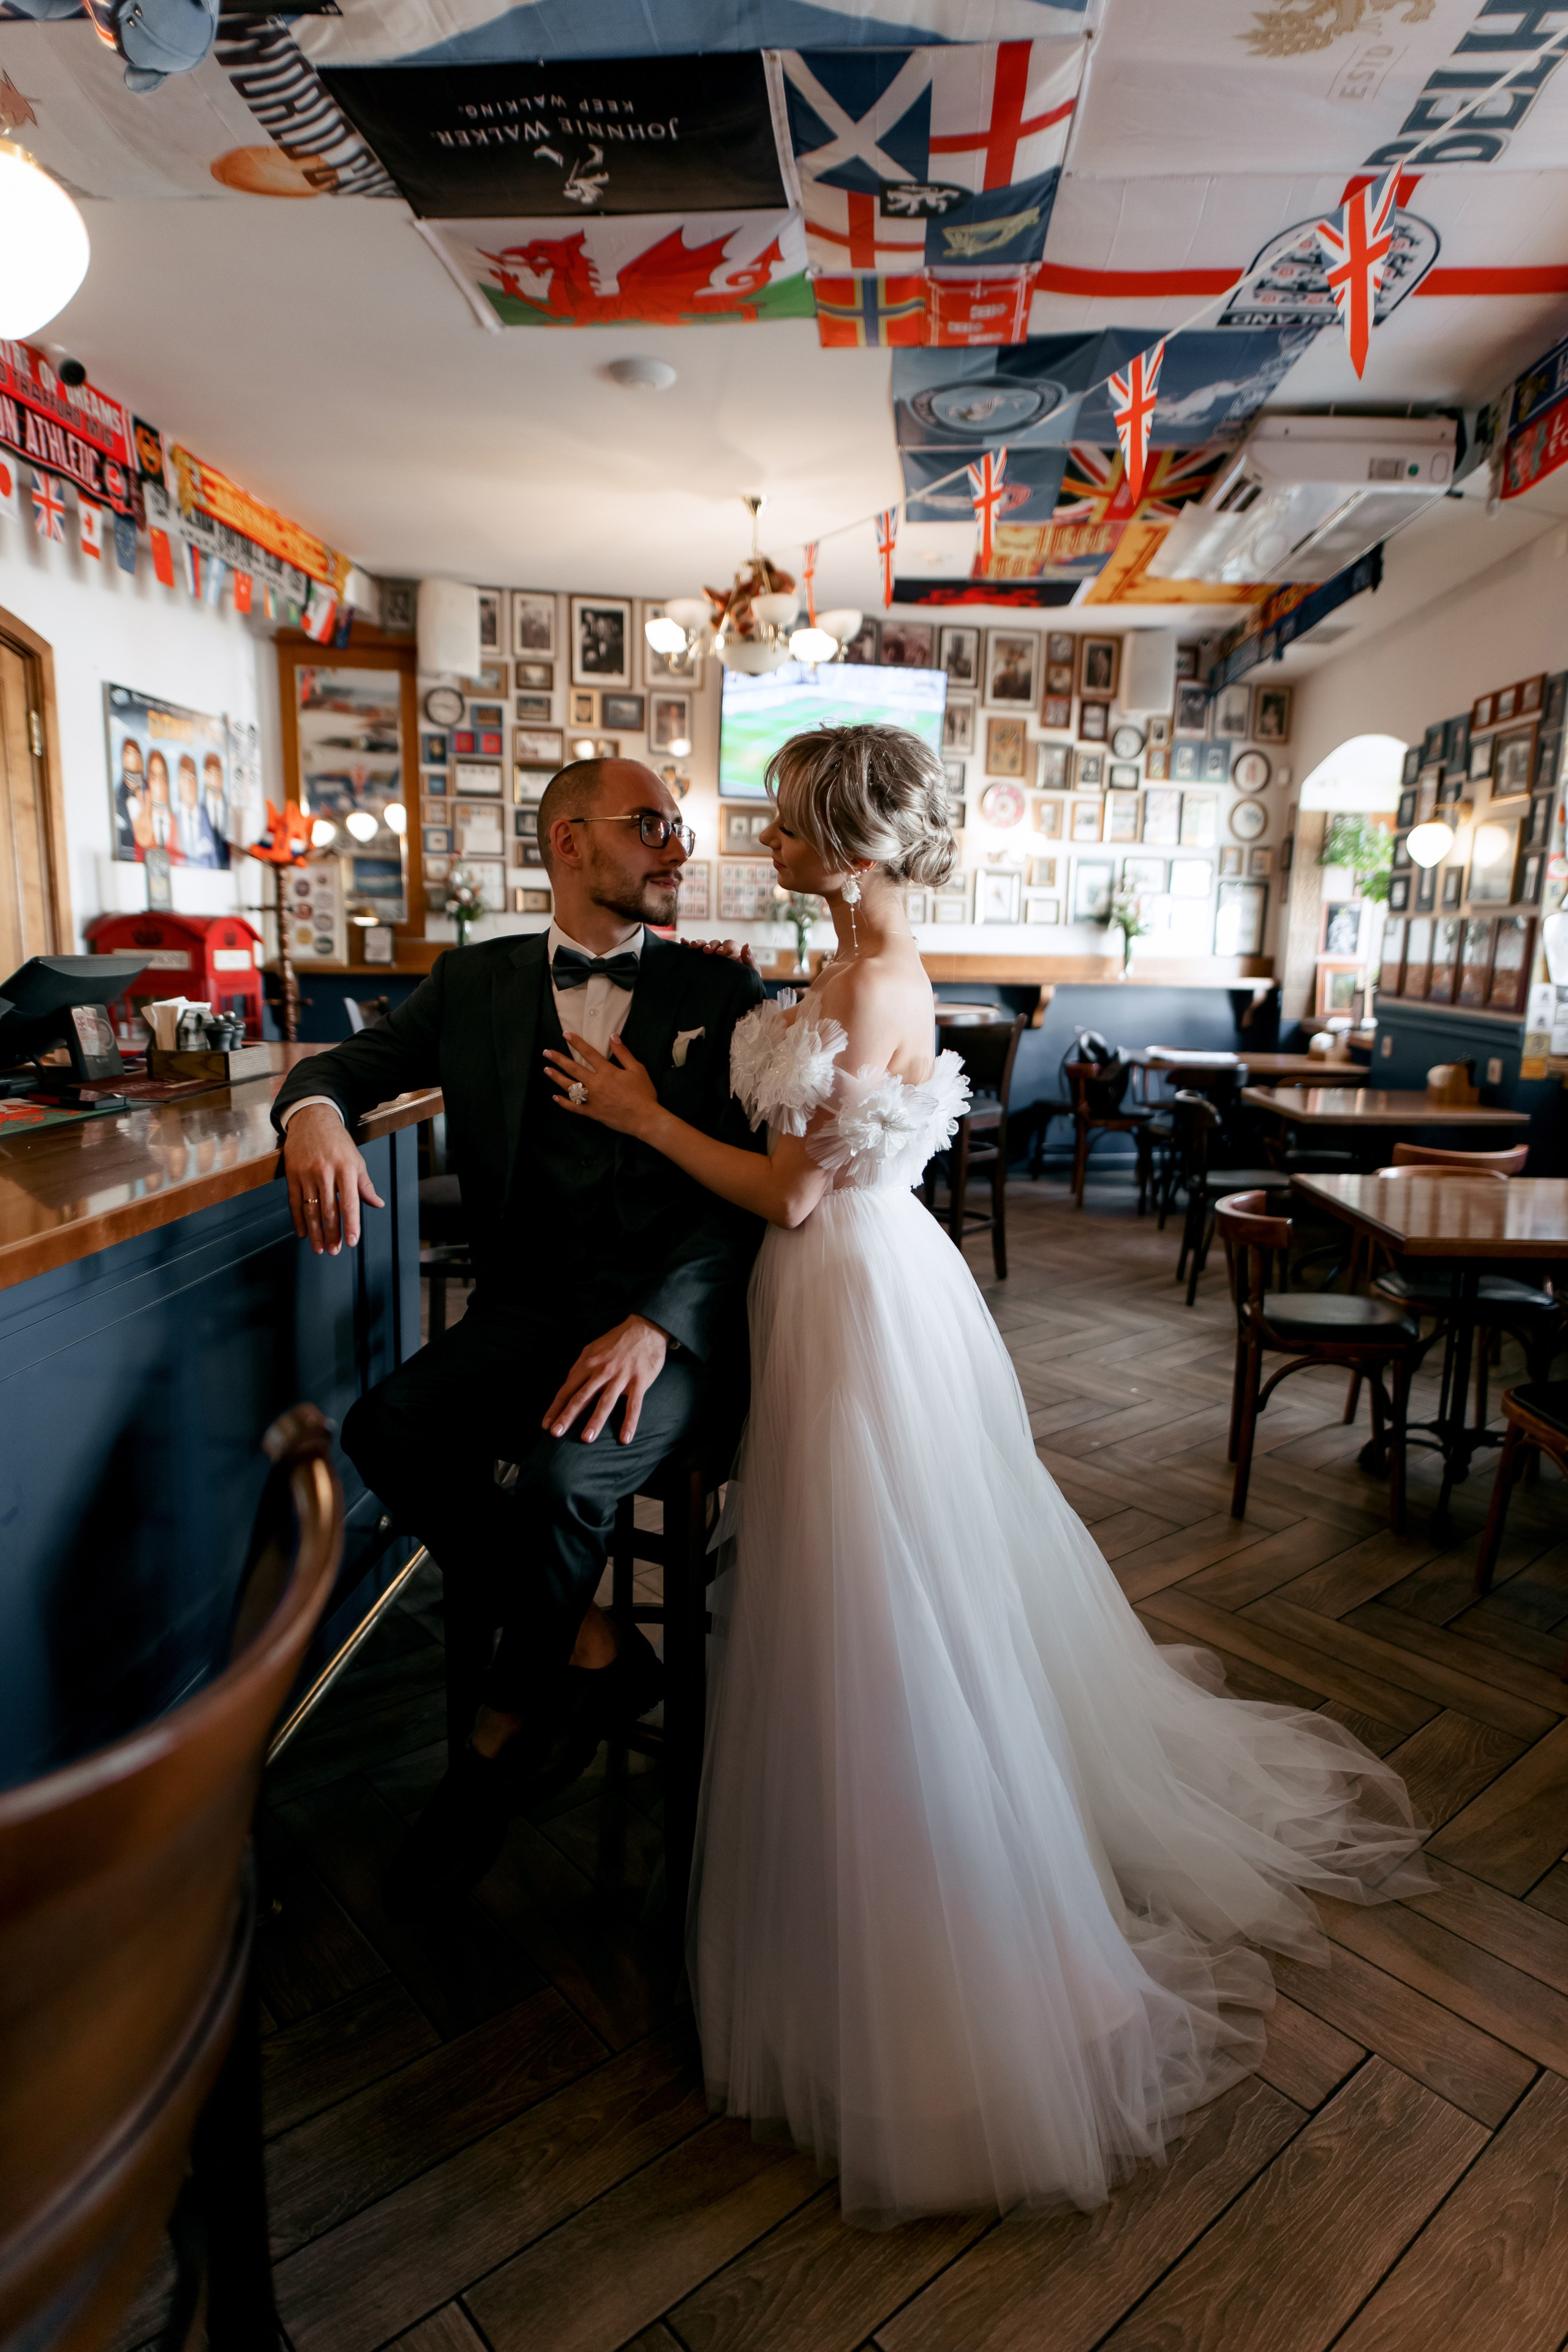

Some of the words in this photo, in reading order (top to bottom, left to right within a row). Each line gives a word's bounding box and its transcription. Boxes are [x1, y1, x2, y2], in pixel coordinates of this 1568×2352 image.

[214, 15, 356, 160] WORLD
[1339, 43, 1393, 100] ESTD
[557, 116, 679, 141] JOHNNIE
[578, 98, 635, 115] KEEP
[12, 369, 81, 428] TRAFFORD
[25, 407, 102, 492] ATHLETIC
